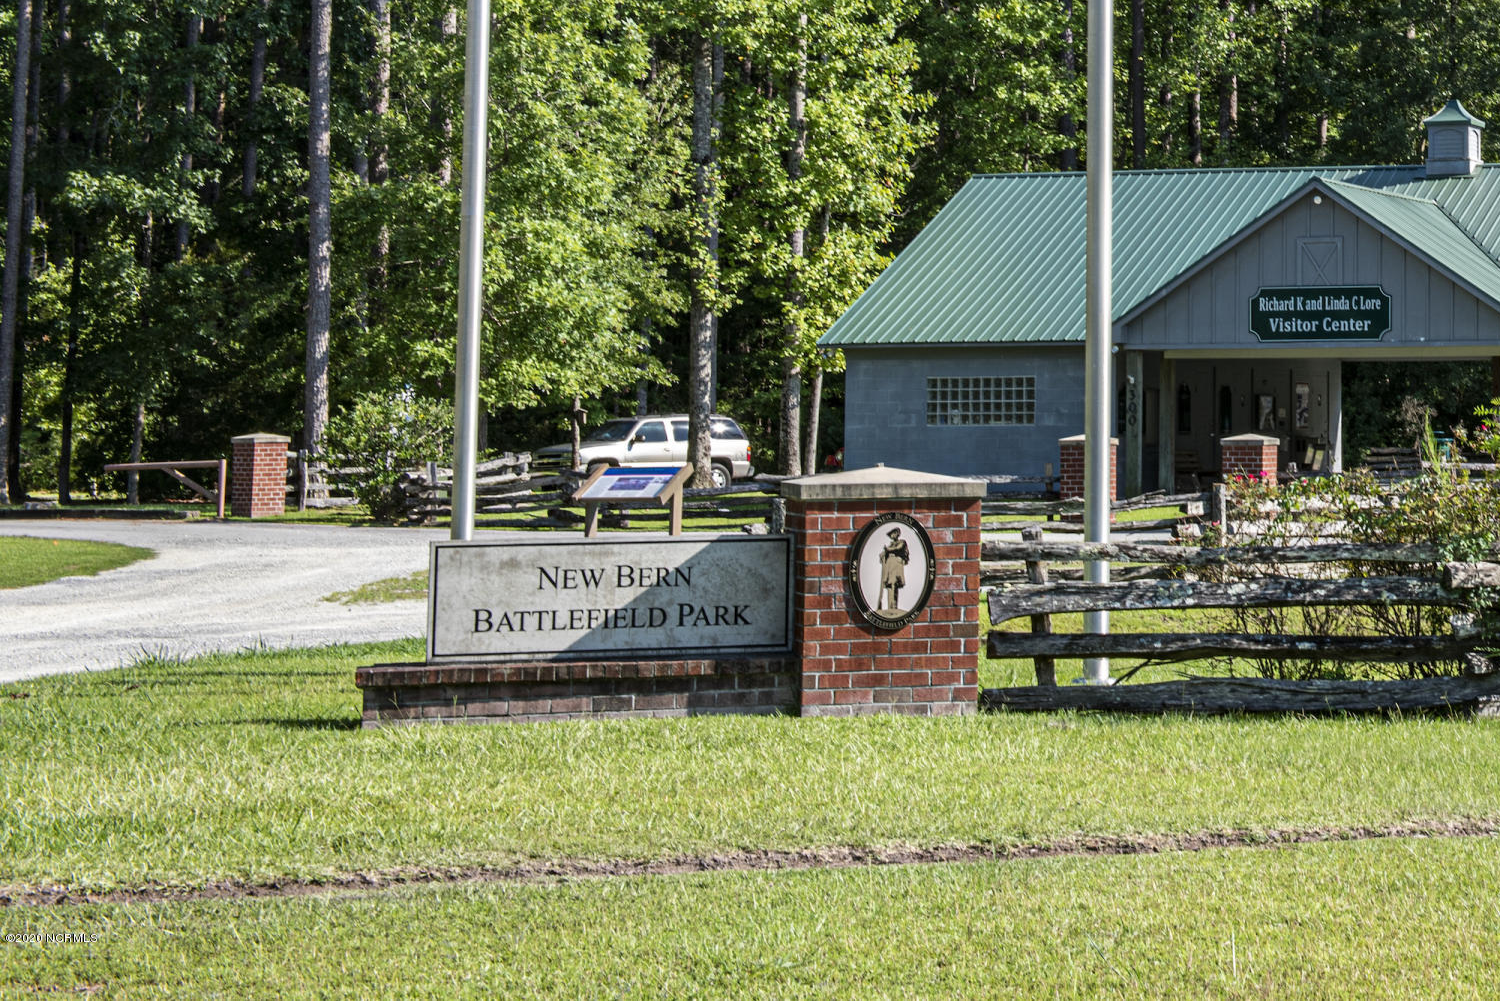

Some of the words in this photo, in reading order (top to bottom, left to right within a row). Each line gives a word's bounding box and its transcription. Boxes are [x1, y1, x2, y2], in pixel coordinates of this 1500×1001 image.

[1259, 296, 1295, 311] Richard
[1296, 296, 1304, 311] K
[1306, 296, 1323, 310] and
[1325, 295, 1350, 310] Linda
[1352, 296, 1358, 310] C
[1360, 295, 1381, 310] Lore
[1269, 318, 1319, 332] Visitor
[1322, 317, 1372, 332] Center
[537, 565, 606, 591] NEW
[616, 563, 692, 589] BERN
[471, 605, 668, 633] BATTLEFIELD
[676, 602, 753, 628] PARK
